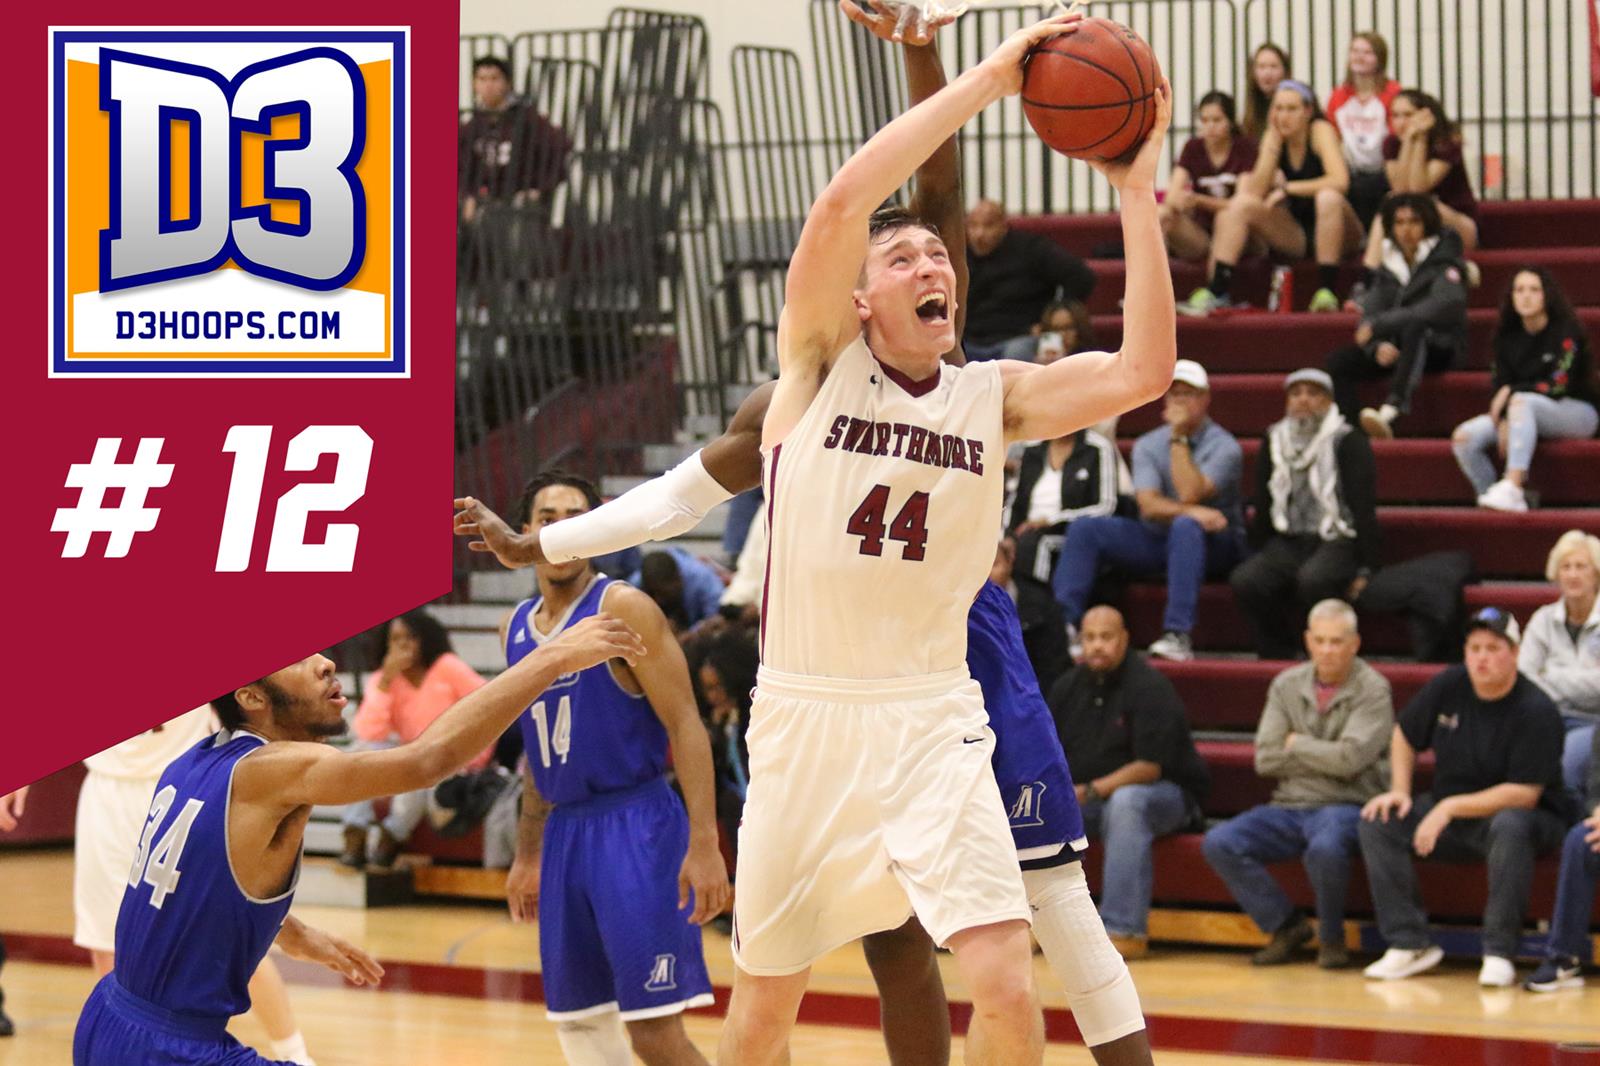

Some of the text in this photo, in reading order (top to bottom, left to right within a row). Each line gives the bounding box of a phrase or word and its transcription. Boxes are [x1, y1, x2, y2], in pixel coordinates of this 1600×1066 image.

[823, 414, 984, 477] SWARTHMORE
[846, 484, 931, 562] 44
[530, 695, 572, 769] 14
[127, 784, 205, 910] 34
